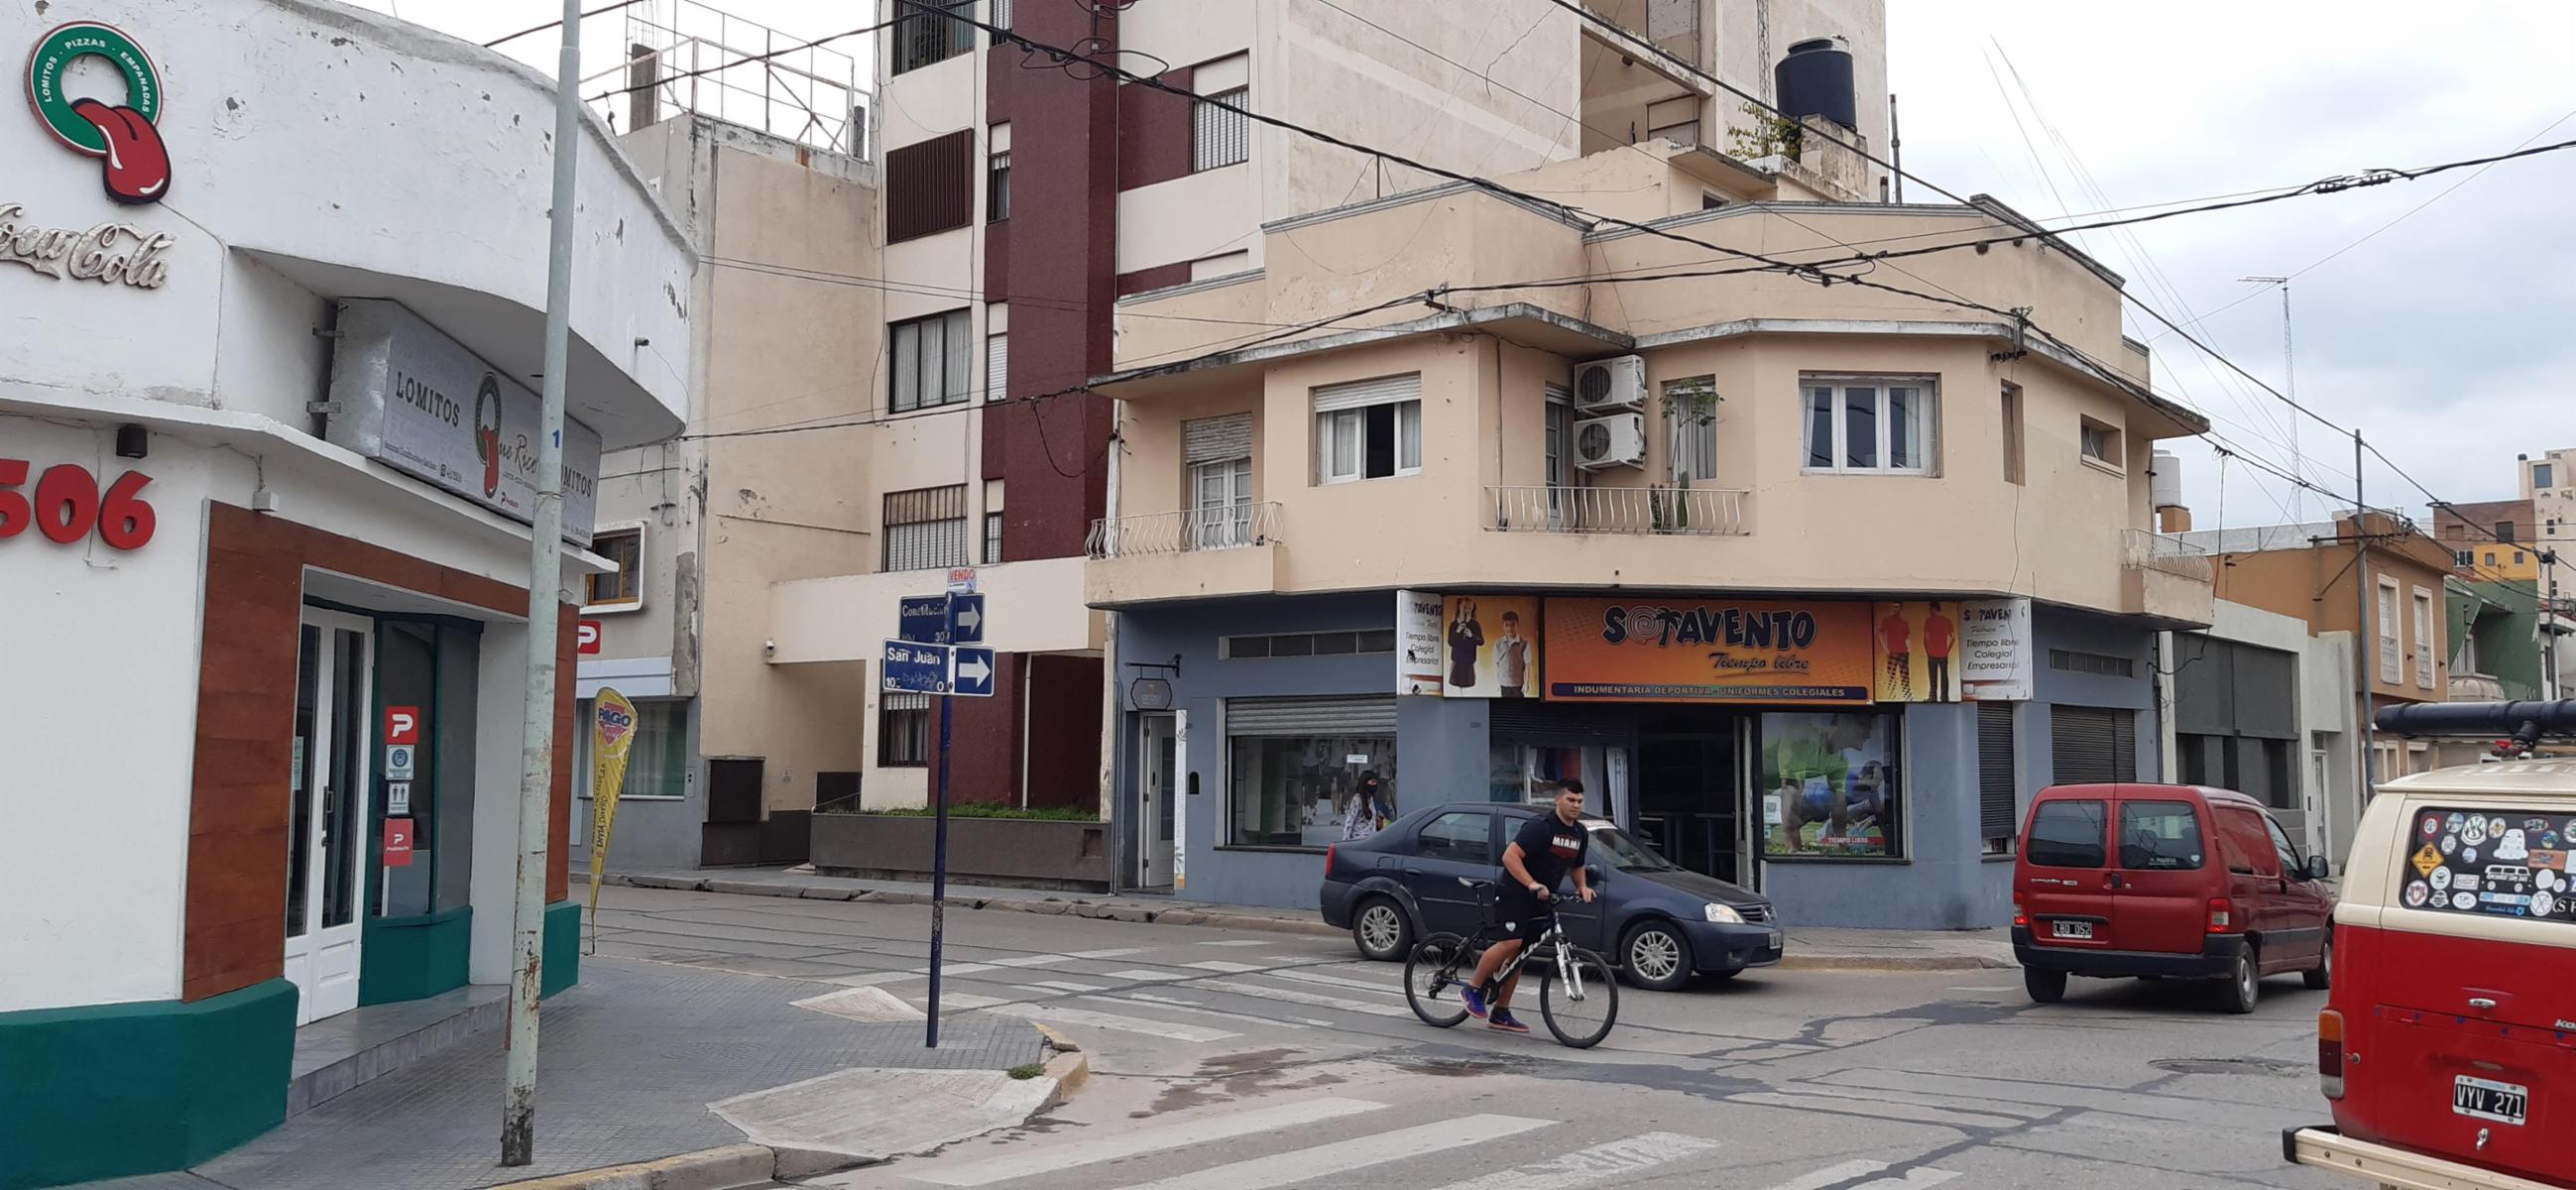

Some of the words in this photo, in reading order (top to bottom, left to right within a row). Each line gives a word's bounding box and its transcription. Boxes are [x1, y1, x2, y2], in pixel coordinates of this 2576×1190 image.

[40, 56, 58, 103] LOMITOS
[64, 38, 106, 50] PIZZAS
[120, 51, 151, 113] EMPANADAS
[397, 371, 460, 428] LOMITOS
[552, 429, 560, 448] 1
[559, 462, 592, 497] MITOS
[950, 569, 976, 582] VENDO
[1601, 605, 1816, 651] SOTAVENTO
[1966, 640, 1998, 649] Tiempo
[887, 648, 909, 662] San
[914, 651, 941, 665] Juan
[1708, 653, 1767, 672] Tiempo
[1773, 654, 1810, 670] libre
[1974, 651, 2013, 659] Colegial
[1574, 685, 1651, 695] INDUMENTARIA
[1655, 686, 1711, 695] DEPORTIVA
[1720, 687, 1779, 697] UNIFORMES
[1782, 688, 1845, 697] COLEGIALES
[1553, 836, 1581, 851] MIAMI
[2458, 1085, 2485, 1110] VYV
[2494, 1092, 2522, 1118] 271
